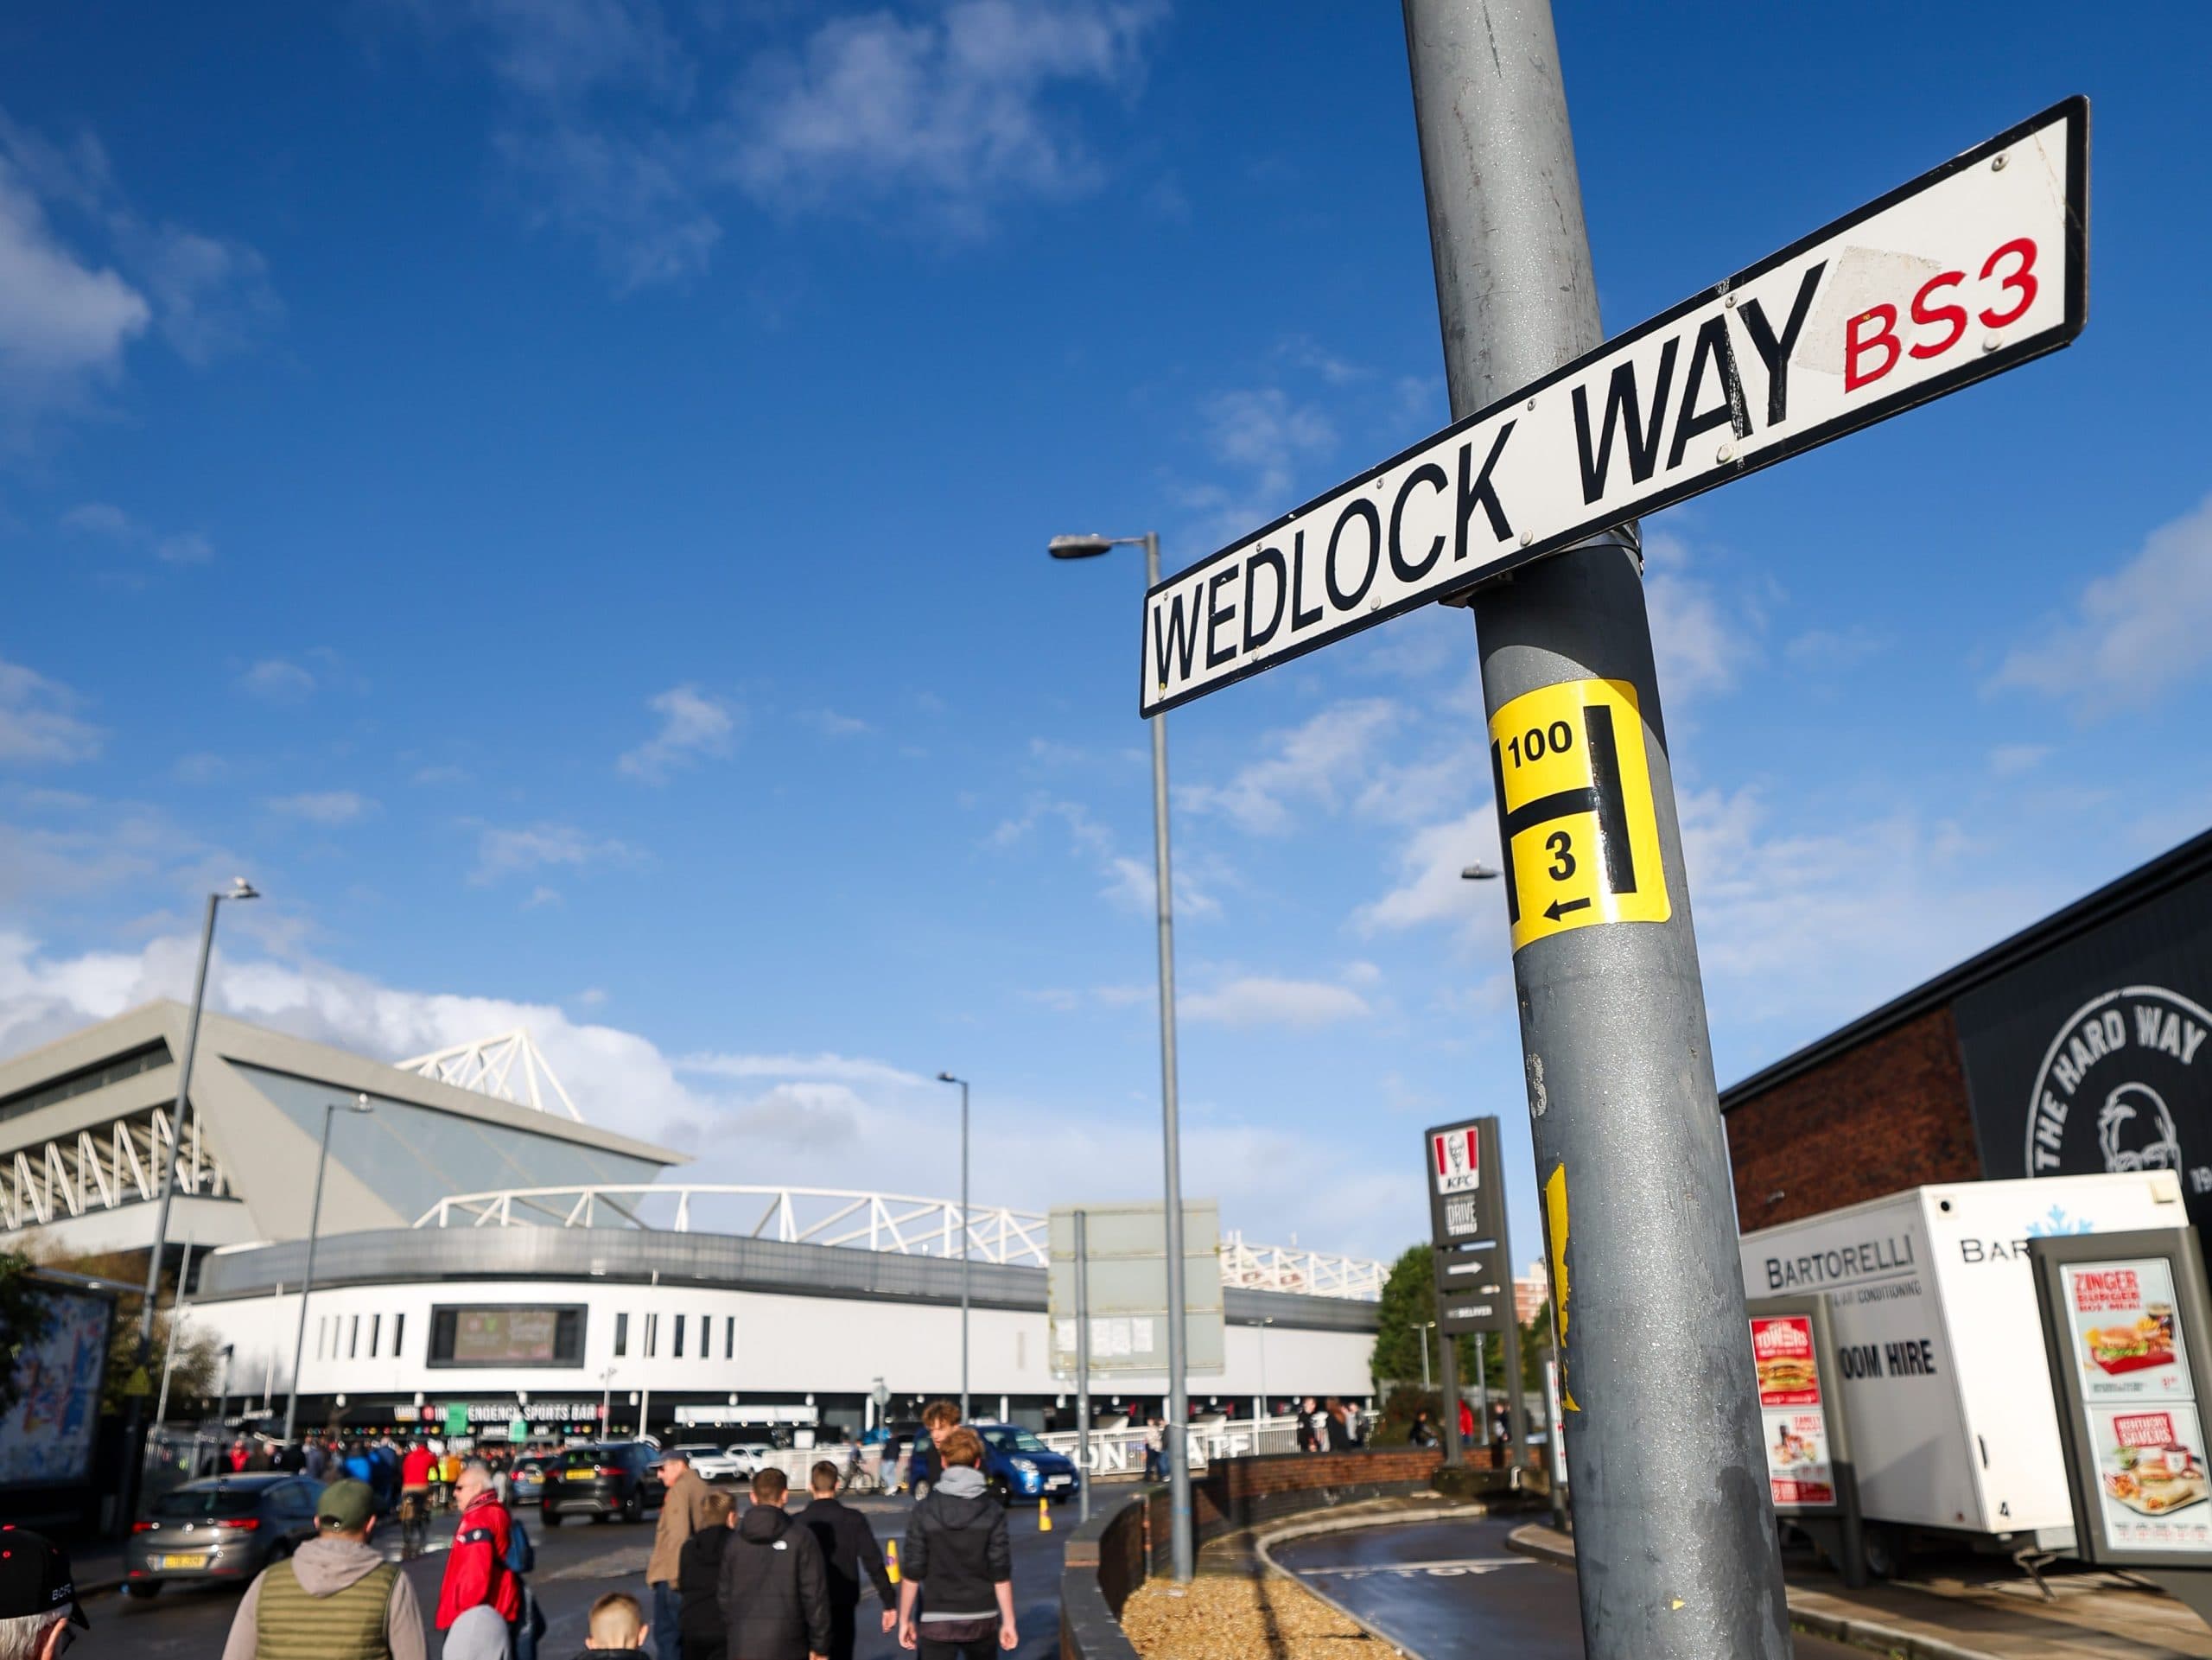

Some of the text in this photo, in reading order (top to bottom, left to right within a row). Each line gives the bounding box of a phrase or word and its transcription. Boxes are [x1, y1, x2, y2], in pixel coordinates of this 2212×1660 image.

[1153, 236, 2039, 688] WEDLOCK WAY BS3
[1508, 721, 1573, 769] 100
[1545, 830, 1576, 881] 3
[2035, 1005, 2207, 1170] THE HARD WAY
[1447, 1174, 1473, 1188] KFC
[1446, 1202, 1477, 1225] DRIVE
[1448, 1223, 1478, 1236] THRU
[1766, 1235, 1915, 1289] BARTORELLI
[1859, 1280, 1923, 1304] CONDITIONING
[2074, 1269, 2138, 1293] ZINGER
[1755, 1325, 1808, 1348] TOWERS
[1886, 1339, 1936, 1375] HIRE
[524, 1403, 570, 1421] SPORTS
[571, 1403, 596, 1421] BAR
